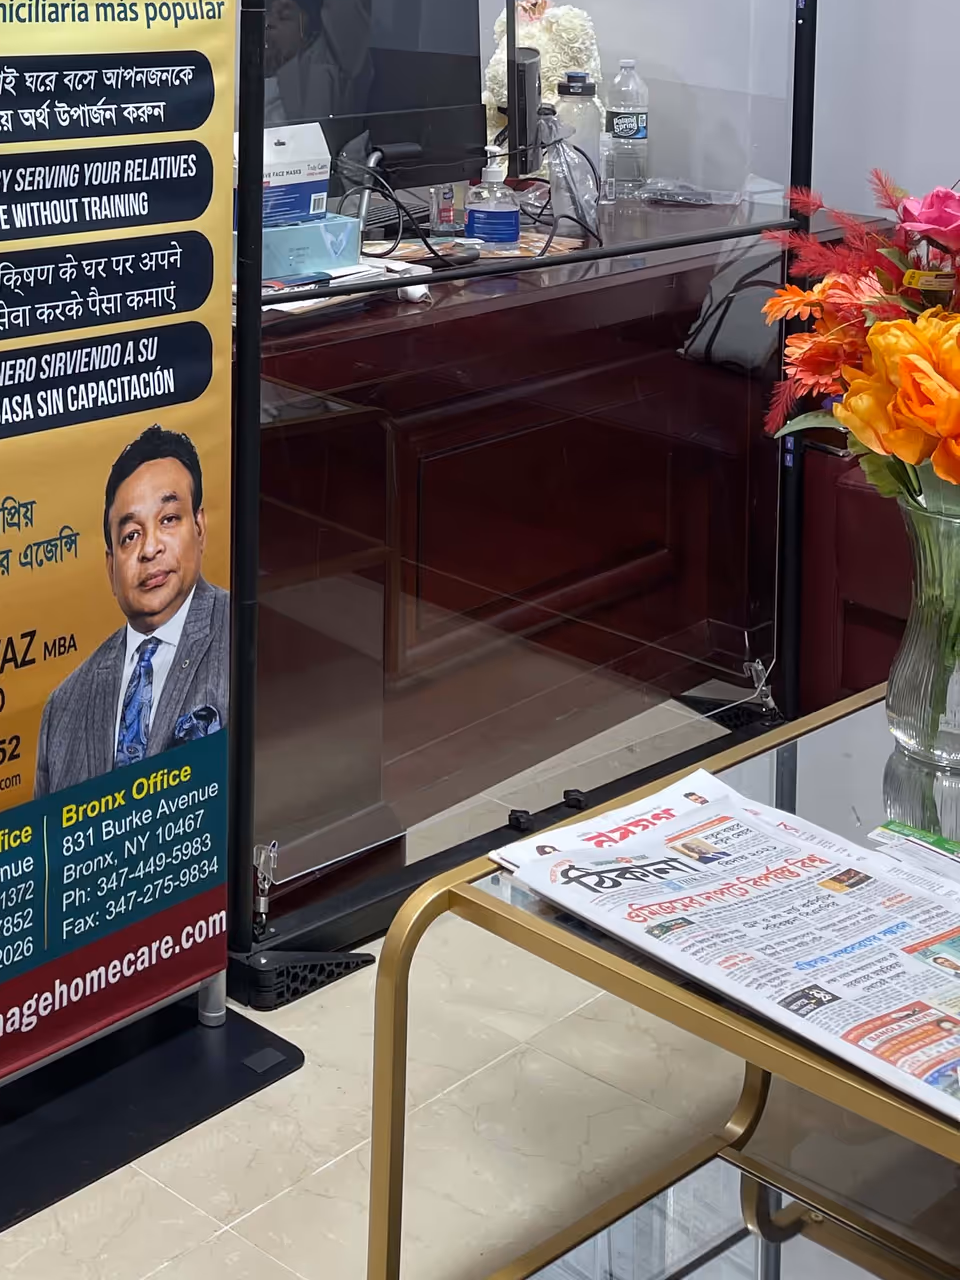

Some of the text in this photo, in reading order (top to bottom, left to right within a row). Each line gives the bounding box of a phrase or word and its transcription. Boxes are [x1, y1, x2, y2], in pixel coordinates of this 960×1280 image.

[25, 71, 58, 92] ঘরে
[63, 70, 98, 92] বসে
[102, 66, 195, 90] আপনজনকে
[18, 100, 51, 130] অর্থ
[54, 97, 117, 128] উপার্জন
[121, 102, 166, 123] করুন
[614, 123, 637, 132] Spring
[14, 164, 79, 192] SERVING
[84, 160, 121, 186] YOUR
[123, 154, 197, 181] RELATIVES
[12, 198, 79, 228] WITHOUT
[82, 192, 148, 221] TRAINING
[59, 254, 80, 282] के
[83, 258, 108, 279] घर
[111, 254, 135, 276] पर
[139, 242, 182, 272] अपने
[35, 291, 83, 324] करके
[87, 287, 122, 316] पैसा
[126, 280, 177, 310] कमाएं
[39, 342, 122, 378] SIRVIENDO
[124, 342, 134, 364] A
[138, 336, 158, 362] SU
[38, 387, 64, 418] SIN
[67, 366, 175, 410] CAPACITACIÓN
[18, 524, 80, 567] এজেন্সি
[43, 633, 77, 660] MBA
[62, 763, 192, 828] Bronx Office
[62, 782, 219, 856] 831 Burke Avenue
[63, 810, 205, 884] Bronx, NY 10467
[62, 833, 212, 912] Ph: 347-449-5983
[561, 856, 701, 893] ঠিকানা
[62, 856, 219, 940] Fax: 347-275-9834
